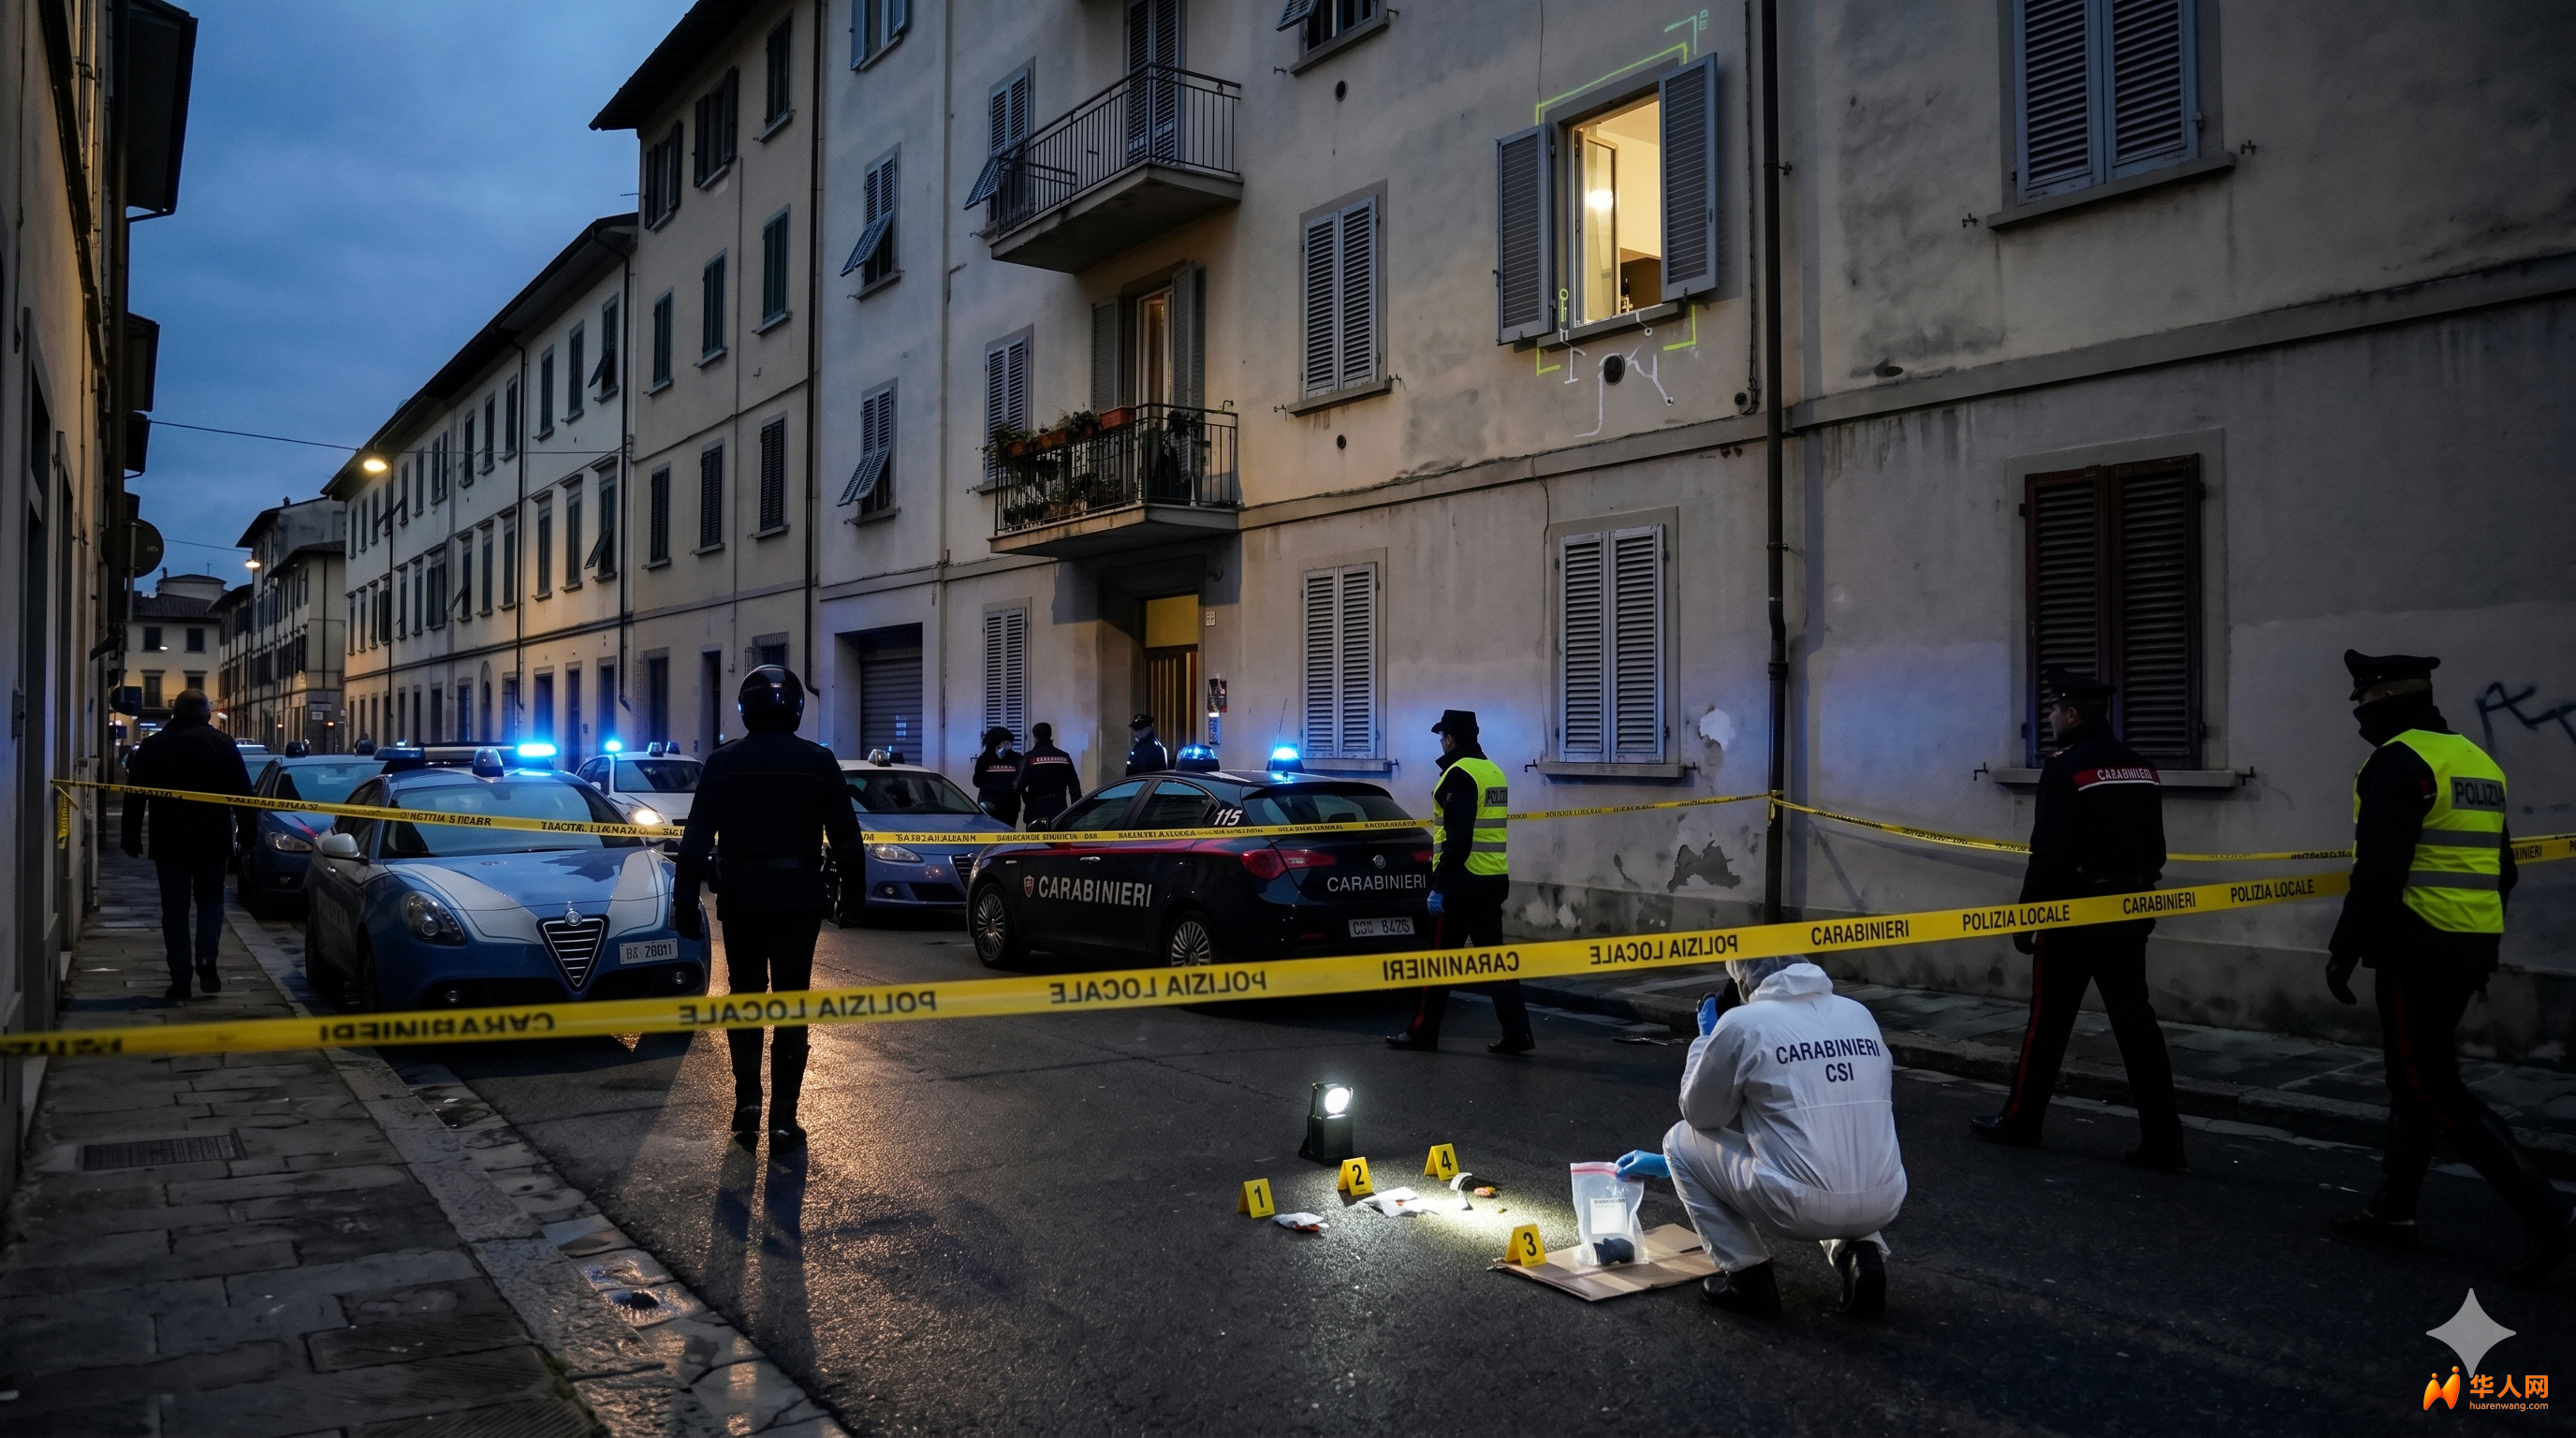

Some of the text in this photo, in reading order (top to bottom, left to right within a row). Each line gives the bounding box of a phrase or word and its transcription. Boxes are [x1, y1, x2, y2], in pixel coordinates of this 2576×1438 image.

[1213, 808, 1243, 826] 115
[1038, 875, 1152, 908] CARABINIERI
[1326, 874, 1427, 892] CARABINIERI
[1810, 878, 2315, 946] CARABINIERI POLIZIA LOCALE CARABINIERI POLIZIA LOCALE
[1776, 1038, 1881, 1065] CARABINIERI
[1825, 1062, 1854, 1082] CSI
[1441, 1150, 1453, 1171] 4
[1352, 1164, 1365, 1186] 2
[1253, 1184, 1265, 1209] 1
[1522, 1231, 1537, 1257] 3
